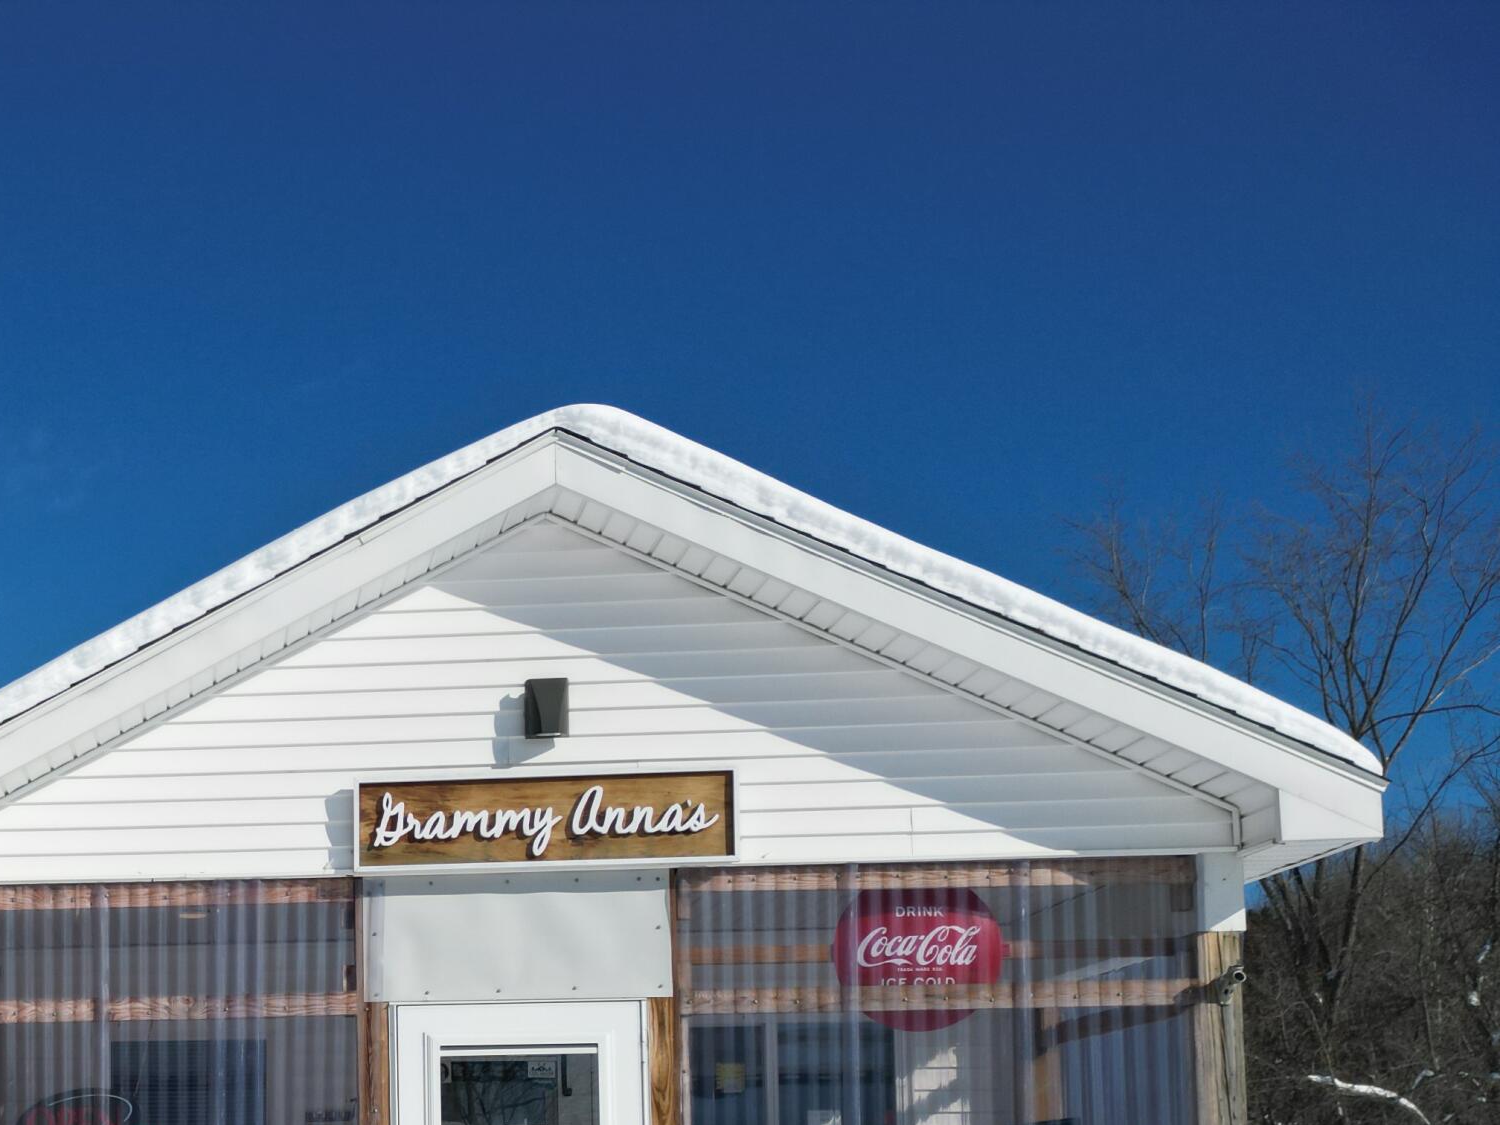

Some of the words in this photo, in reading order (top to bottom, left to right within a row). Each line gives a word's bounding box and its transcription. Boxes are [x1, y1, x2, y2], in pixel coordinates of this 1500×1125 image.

[373, 791, 562, 856] Grammy
[572, 785, 720, 836] Anna's
[895, 906, 944, 917] DRINK
[857, 925, 980, 967] Coca-Cola
